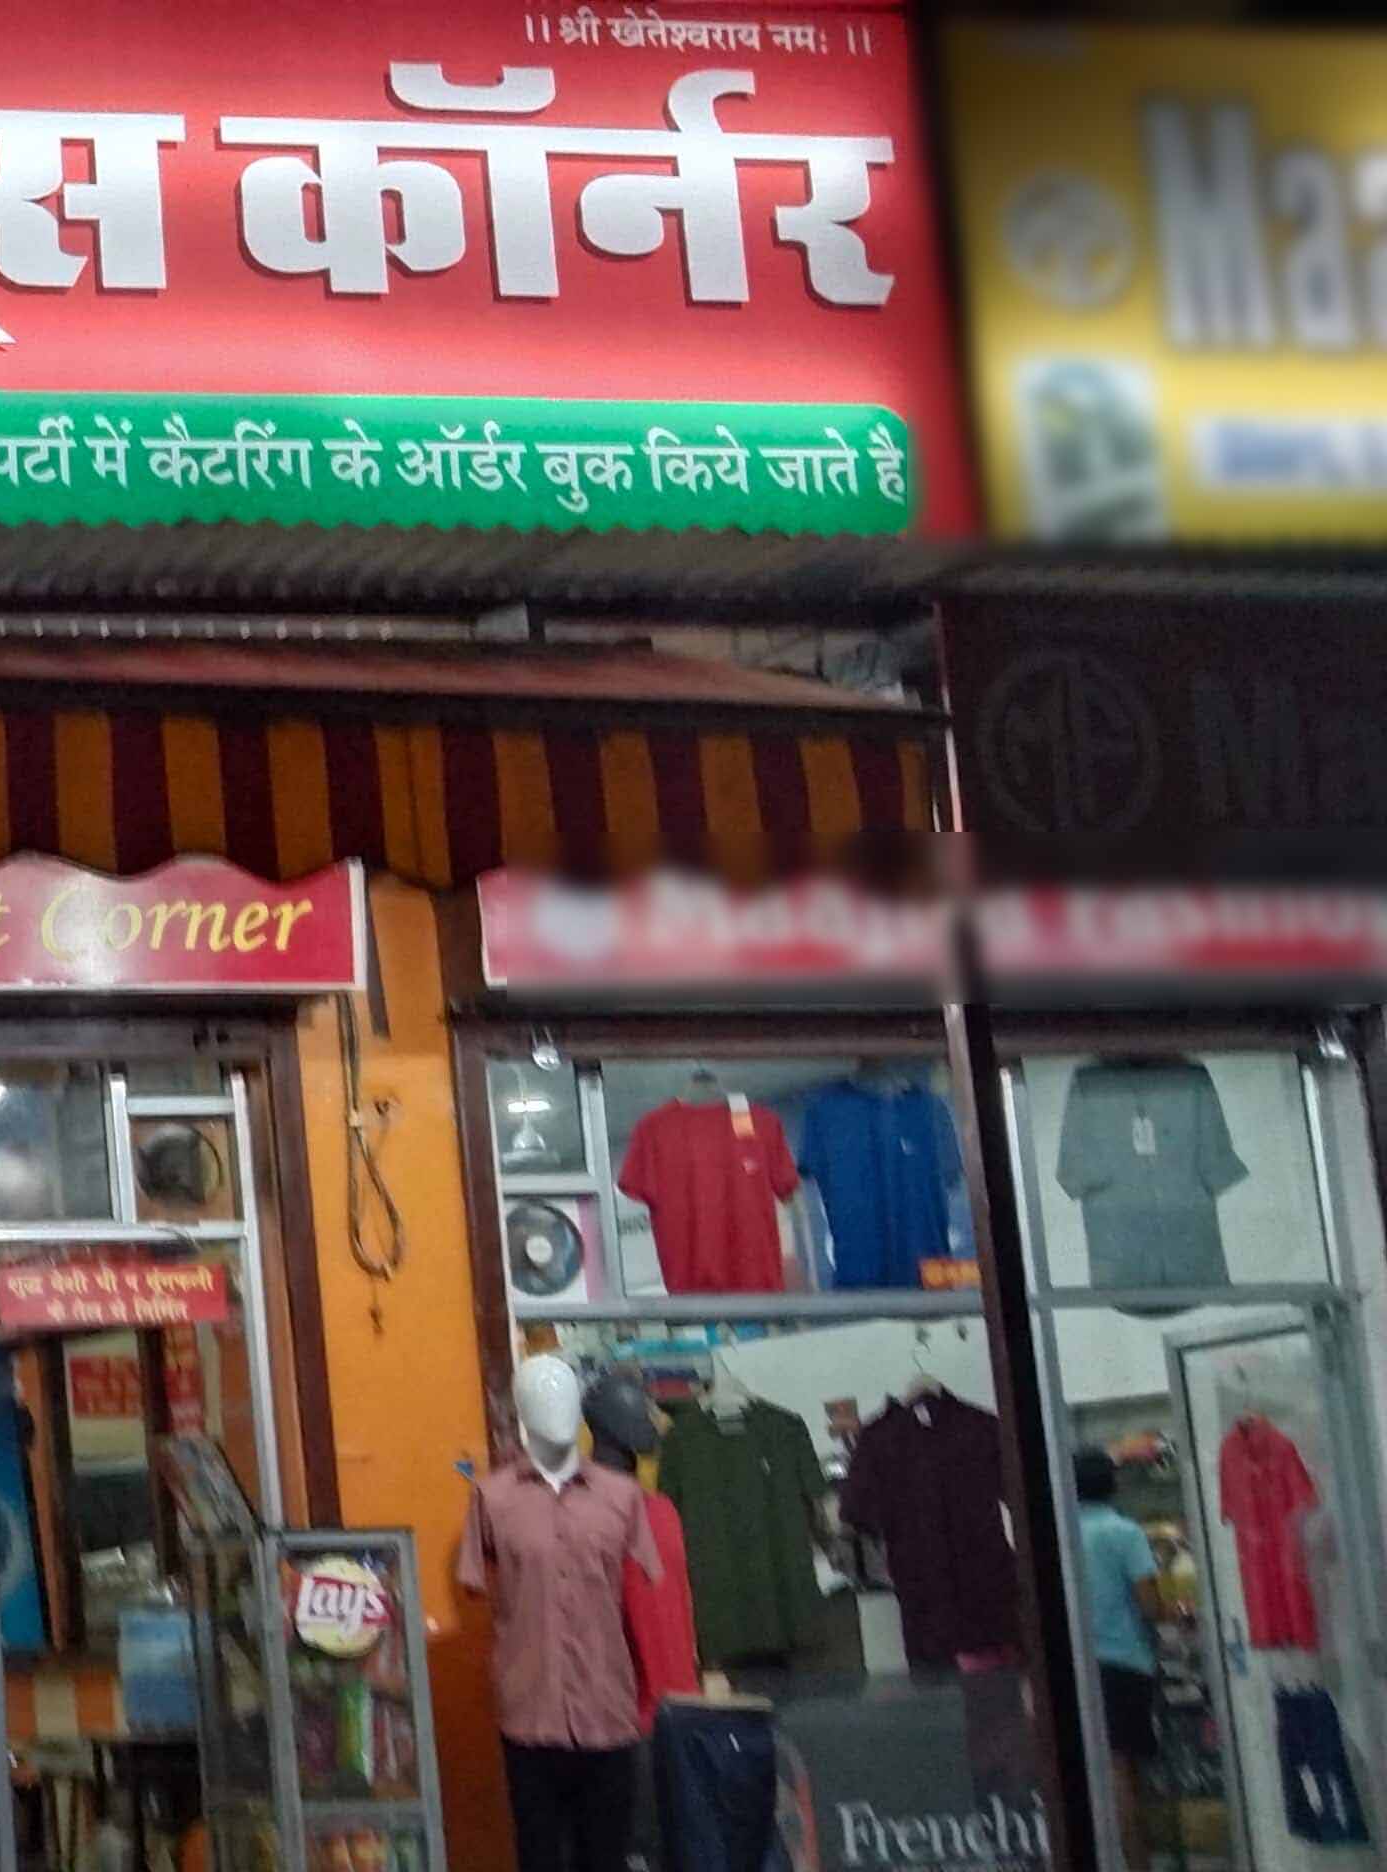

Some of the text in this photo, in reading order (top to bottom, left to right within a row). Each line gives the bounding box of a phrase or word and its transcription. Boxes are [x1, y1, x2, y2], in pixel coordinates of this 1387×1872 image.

[558, 7, 601, 46] श्री
[220, 62, 895, 306] कॉर्नर
[85, 415, 133, 487] में
[141, 413, 312, 490] कैटरिंग
[323, 418, 384, 488] के
[397, 421, 527, 490] ऑर्डर
[537, 438, 635, 513] बुक
[643, 426, 750, 494] किये
[762, 427, 860, 496] जाते
[865, 424, 907, 503] है
[39, 884, 314, 963] Corner
